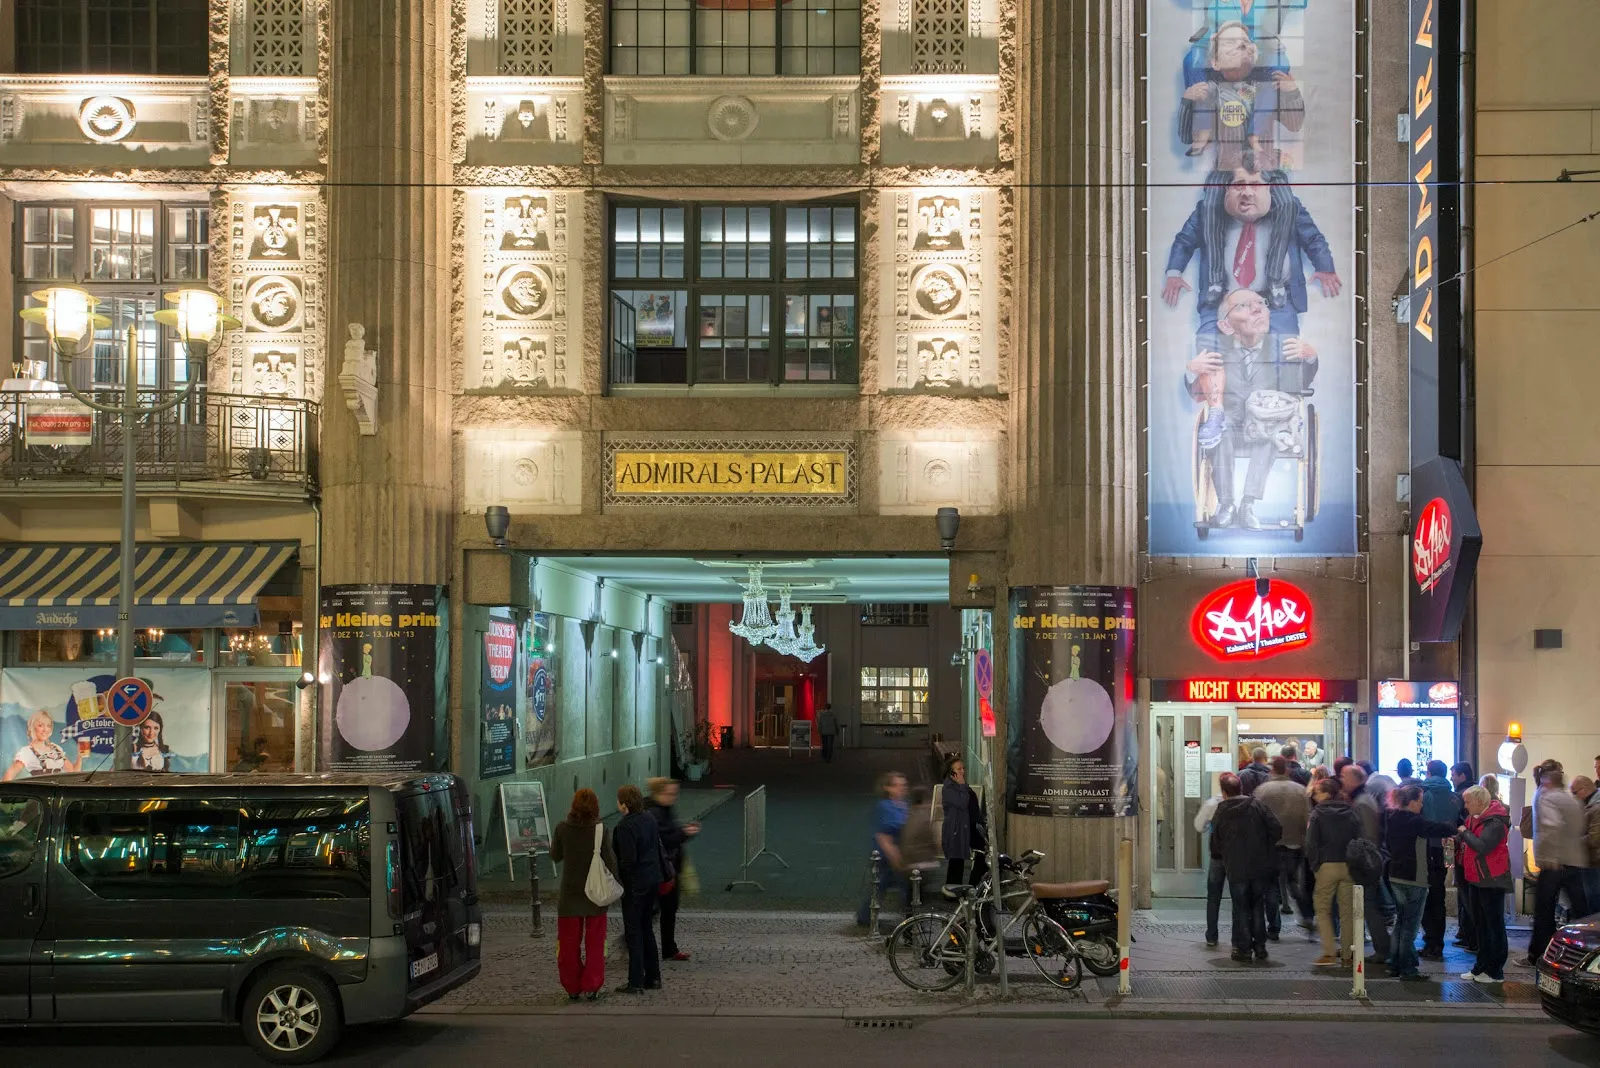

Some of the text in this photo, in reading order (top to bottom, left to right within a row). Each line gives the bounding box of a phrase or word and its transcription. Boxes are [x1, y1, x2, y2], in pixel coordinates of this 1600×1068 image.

[1223, 105, 1243, 113] MEHR
[1222, 113, 1245, 122] NETTO
[336, 612, 393, 627] kleine
[1013, 614, 1036, 629] der
[1040, 613, 1100, 629] kleine
[1093, 632, 1106, 640] JAN
[1226, 631, 1307, 654] Kabarett Theater DISTEL
[488, 643, 512, 659] THEATER
[490, 665, 509, 679] BERLIN
[1189, 681, 1321, 700] NICHT VERPASSEN!
[1042, 788, 1110, 796] ADMIRALSPALAST
